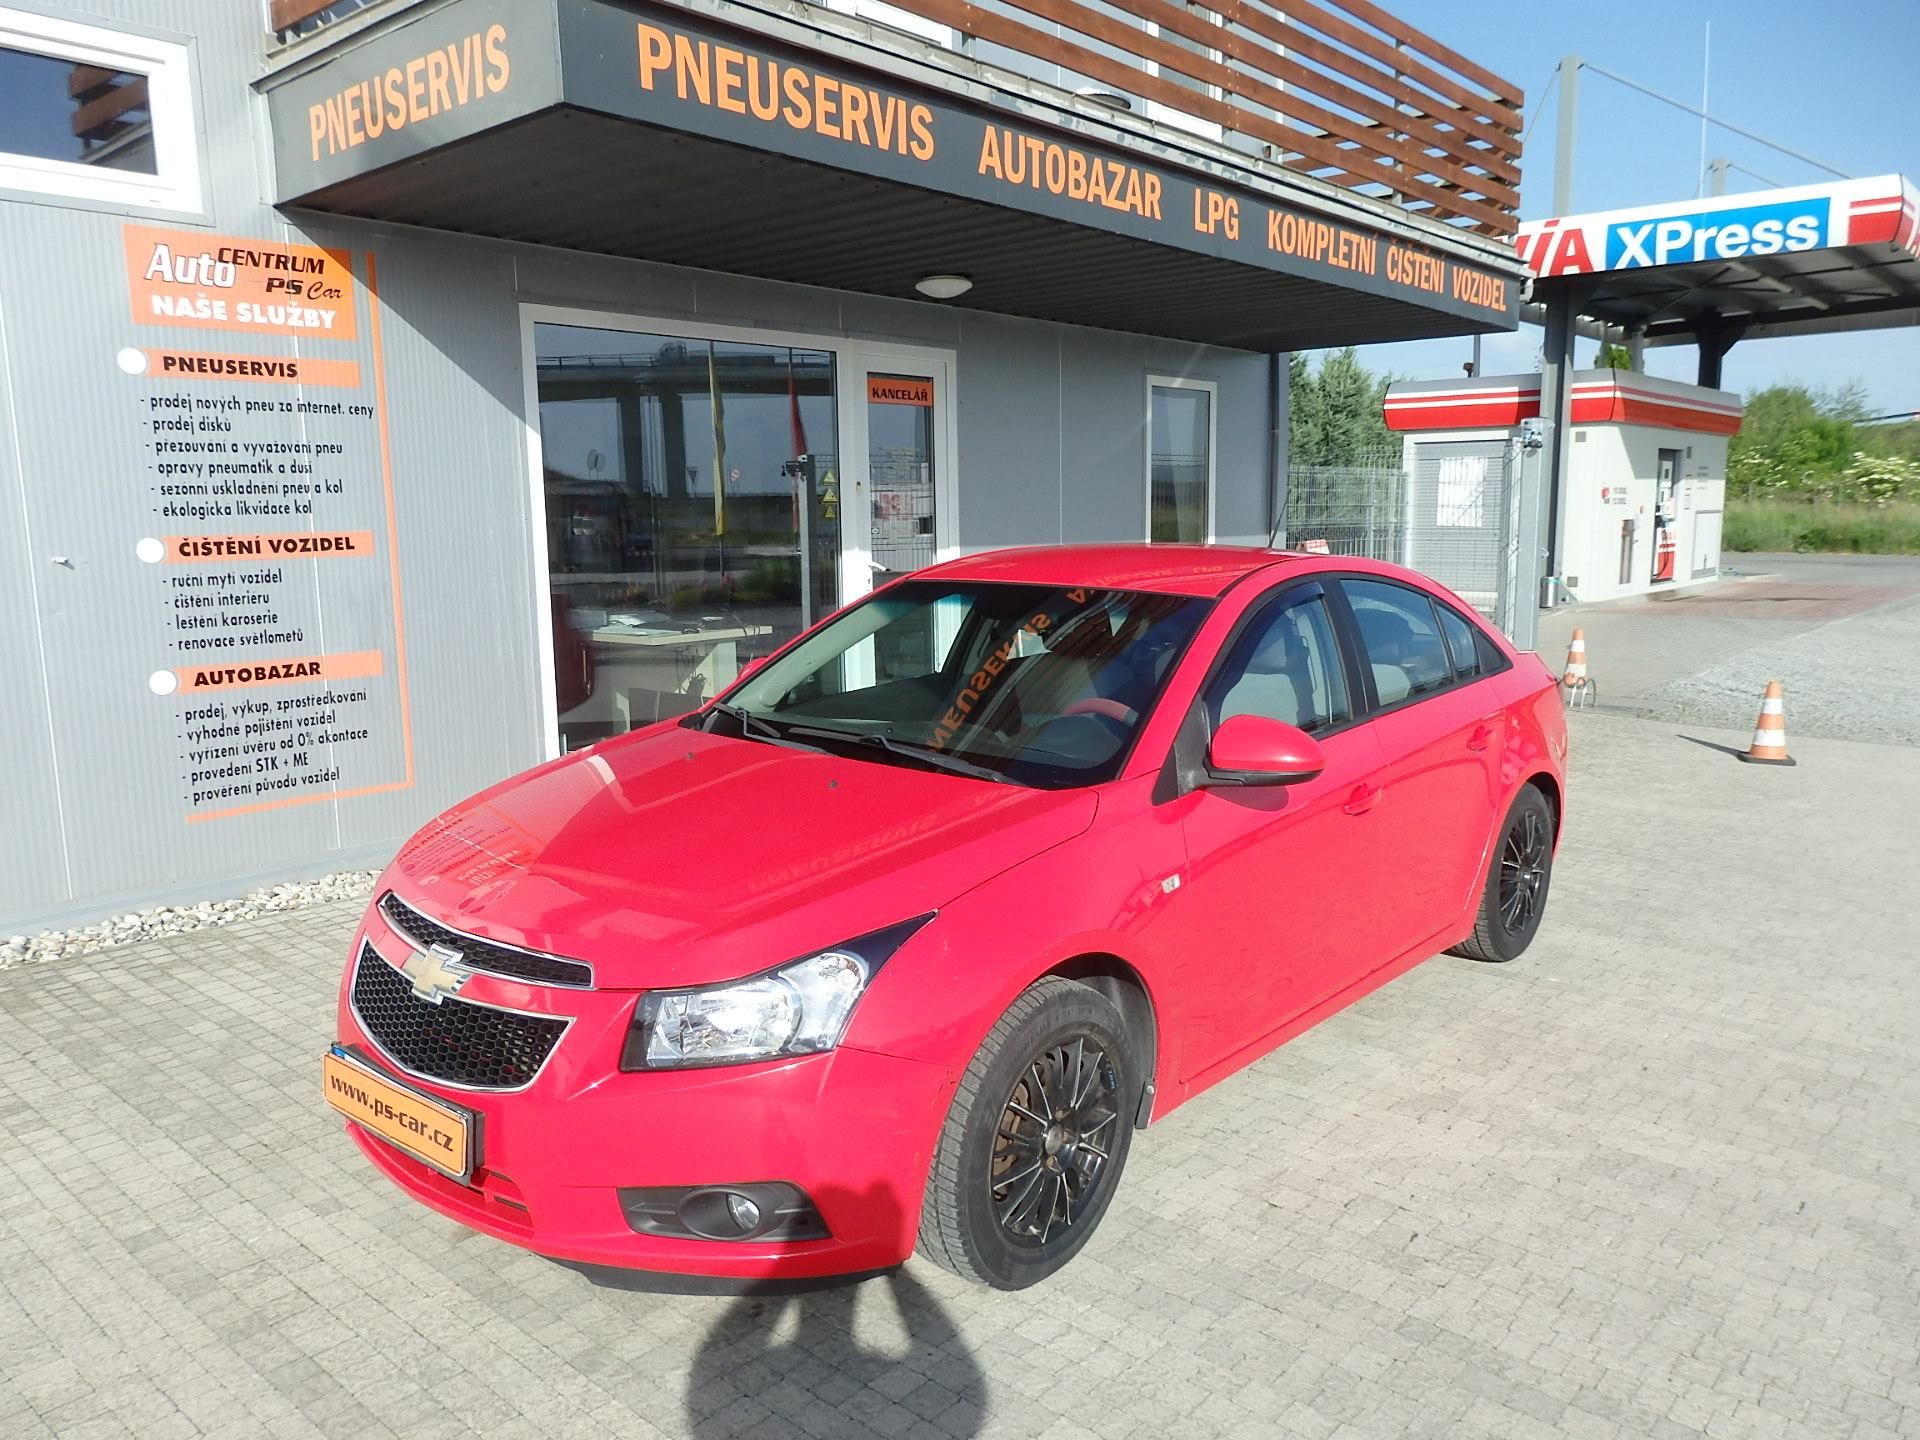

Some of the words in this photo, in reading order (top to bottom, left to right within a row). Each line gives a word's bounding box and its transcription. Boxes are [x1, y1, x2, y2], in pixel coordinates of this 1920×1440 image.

[309, 23, 511, 162] PNEUSERVIS
[638, 23, 935, 162] PNEUSERVIS
[978, 124, 1162, 221] AUTOBAZAR
[1193, 188, 1239, 241] LPG
[1268, 210, 1377, 276] KOMPLETNÍ
[1387, 236, 1445, 294] ČIŠTĚNÍ
[1453, 265, 1508, 313] VOZIDEL
[1616, 214, 1821, 270] XPress
[144, 242, 237, 288] Auto
[218, 247, 325, 275] CENTRUM
[265, 277, 303, 295] PS
[307, 282, 343, 301] Car
[151, 292, 228, 321] NAŠE
[237, 302, 337, 329] SLUŽBY
[163, 356, 298, 378] PNEUSERVIS
[150, 393, 192, 413] prodej
[196, 396, 241, 414] nových
[246, 400, 275, 415] pneu
[279, 402, 293, 413] za
[348, 404, 374, 419] ceny
[872, 387, 928, 402] KANCELÁŘ
[153, 416, 195, 435] prodej
[232, 443, 239, 453] a
[316, 442, 343, 456] pneu
[158, 461, 203, 477] opravy
[209, 458, 274, 476] pneumatik
[278, 464, 286, 474] a
[282, 483, 310, 499] pneu
[314, 483, 321, 494] a
[325, 479, 343, 494] kol
[236, 500, 290, 516] likvidace
[294, 499, 312, 514] kol
[178, 536, 262, 558] ČIŠTĚNÍ
[268, 536, 356, 554] VOZIDEL
[172, 572, 204, 588] ruční
[207, 571, 236, 590] mytí
[240, 568, 283, 584] vozidel
[174, 593, 214, 609] čištění
[217, 590, 270, 606] interiéru
[175, 613, 218, 630] leštění
[221, 611, 278, 627] karoserie
[178, 635, 235, 651] renovace
[240, 628, 304, 647] světlometů
[194, 661, 322, 687] AUTOBAZAR
[187, 724, 240, 744] výhodné
[244, 718, 293, 737] pojištění
[296, 710, 336, 728] vozidel
[280, 734, 294, 750] od
[297, 732, 315, 749] 0%
[318, 728, 369, 746] akontace
[191, 763, 252, 786] provedení
[256, 755, 279, 773] STK
[293, 752, 309, 768] ME
[193, 783, 252, 806] prověření
[255, 777, 297, 799] původu
[301, 767, 341, 786] vozidel
[331, 1074, 454, 1152] www.ps-car.cz
